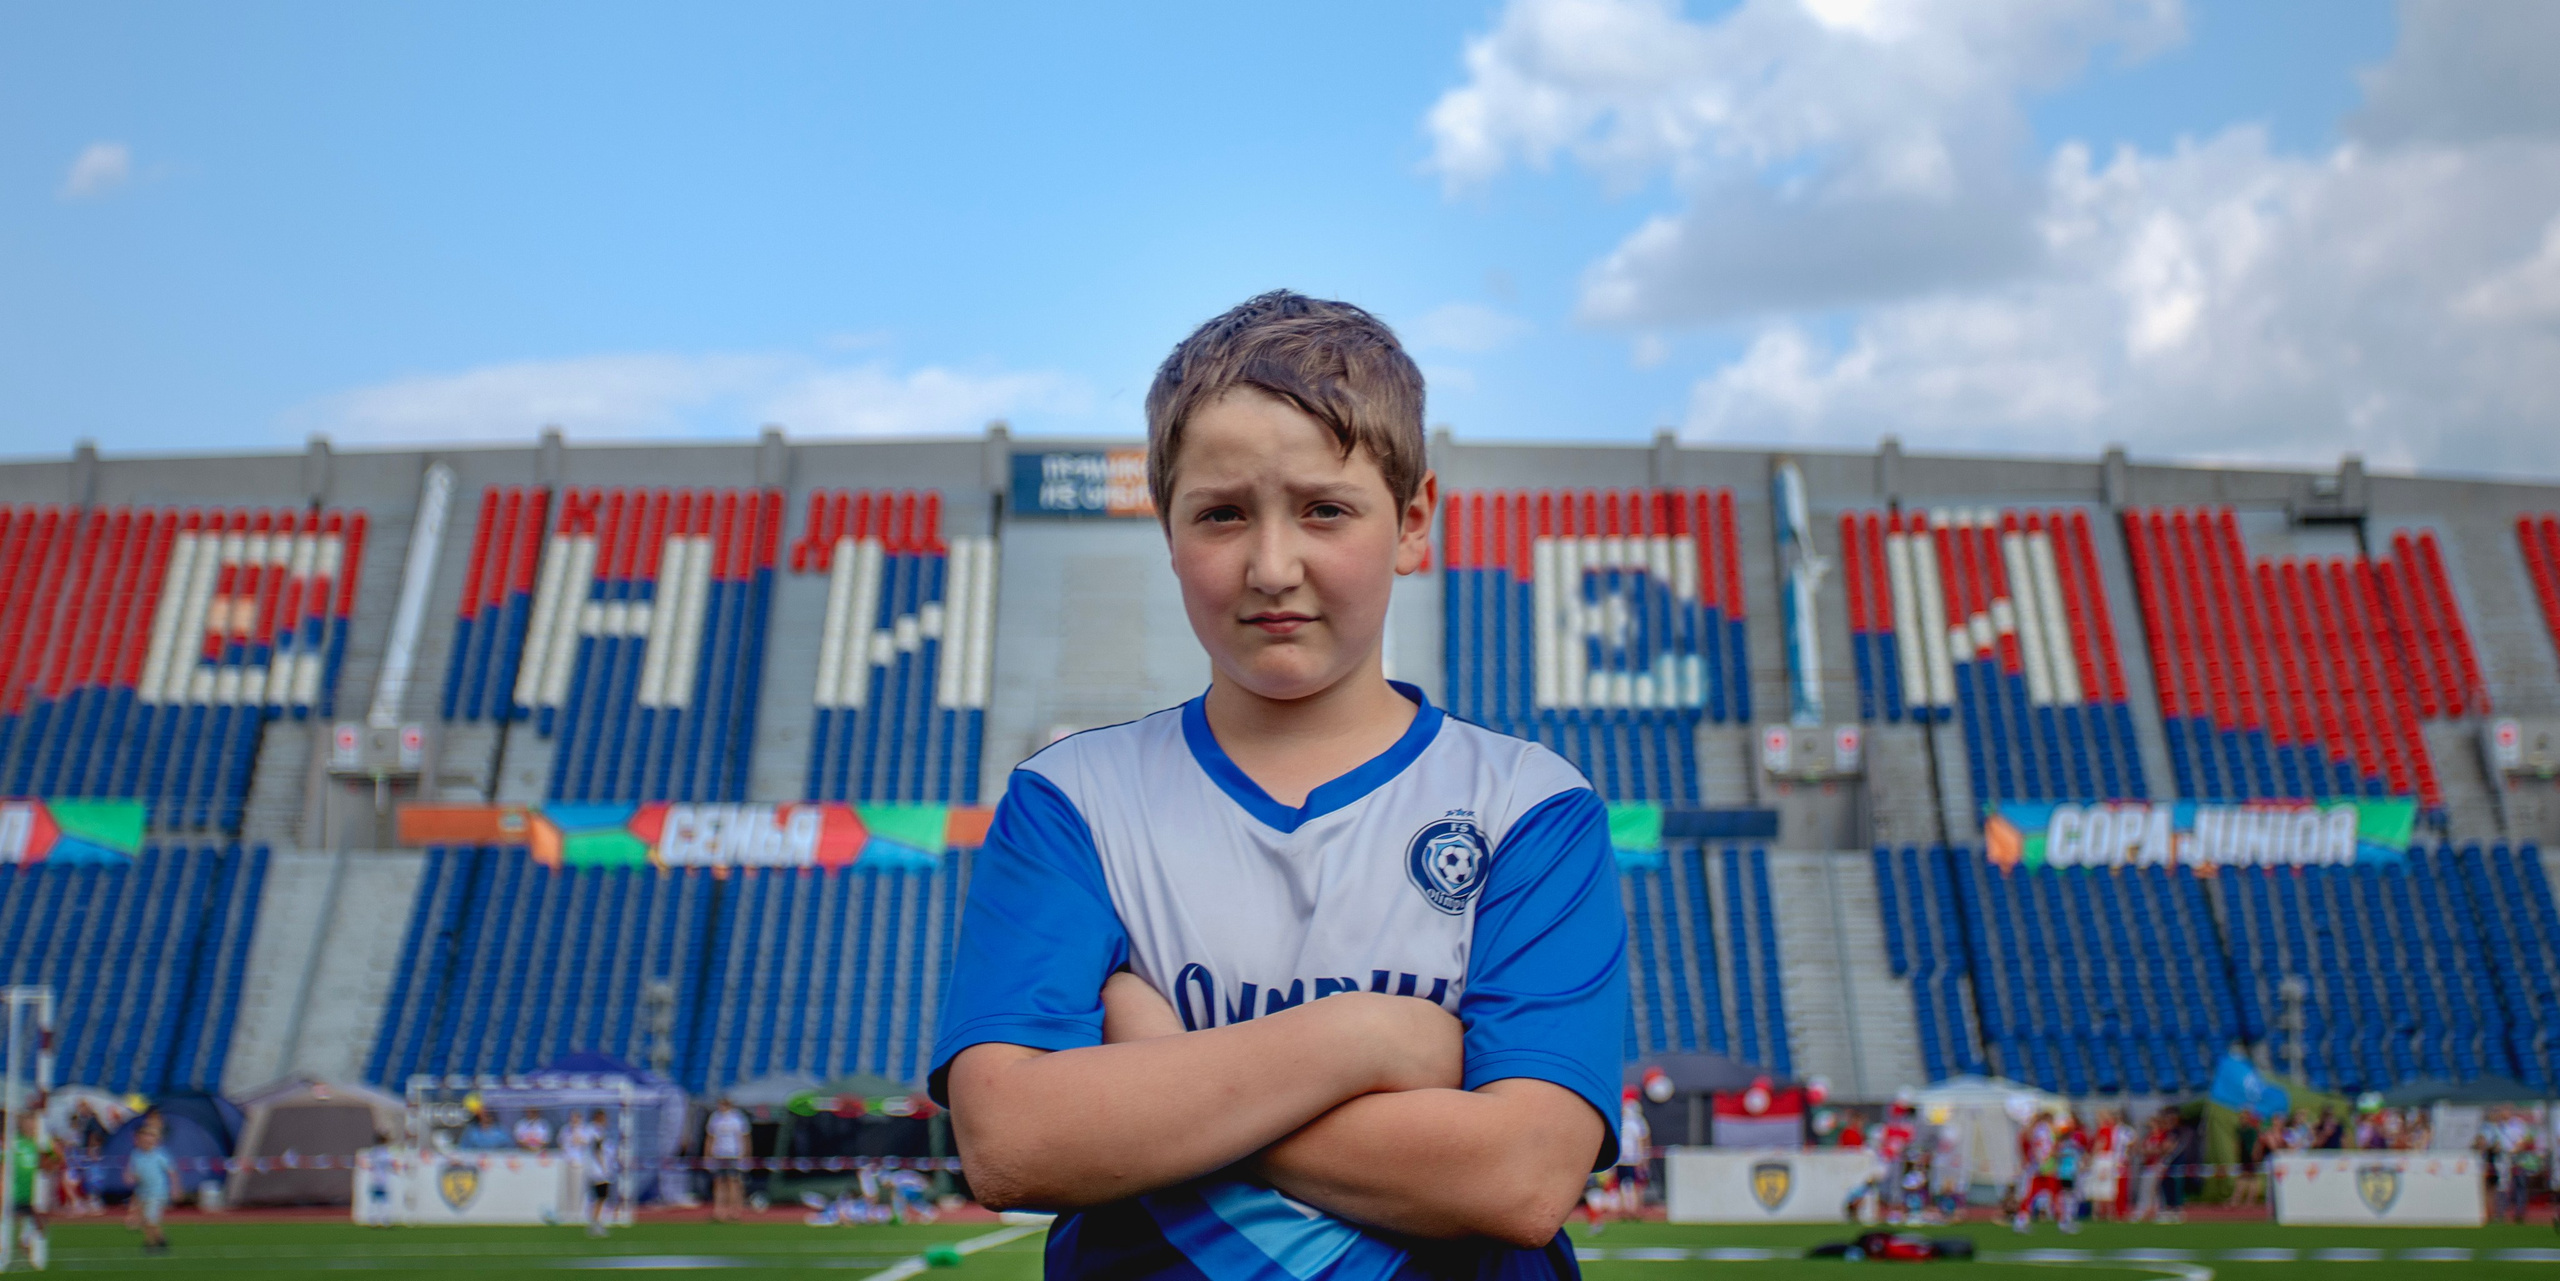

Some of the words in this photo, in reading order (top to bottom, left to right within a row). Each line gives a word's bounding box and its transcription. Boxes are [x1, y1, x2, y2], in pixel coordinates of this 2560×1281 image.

[659, 802, 821, 866] СЕМЬЯ
[1450, 822, 1470, 833] FS
[2047, 802, 2172, 868] COPA
[2176, 803, 2358, 868] JUNIOR
[1426, 888, 1466, 911] Olimpi
